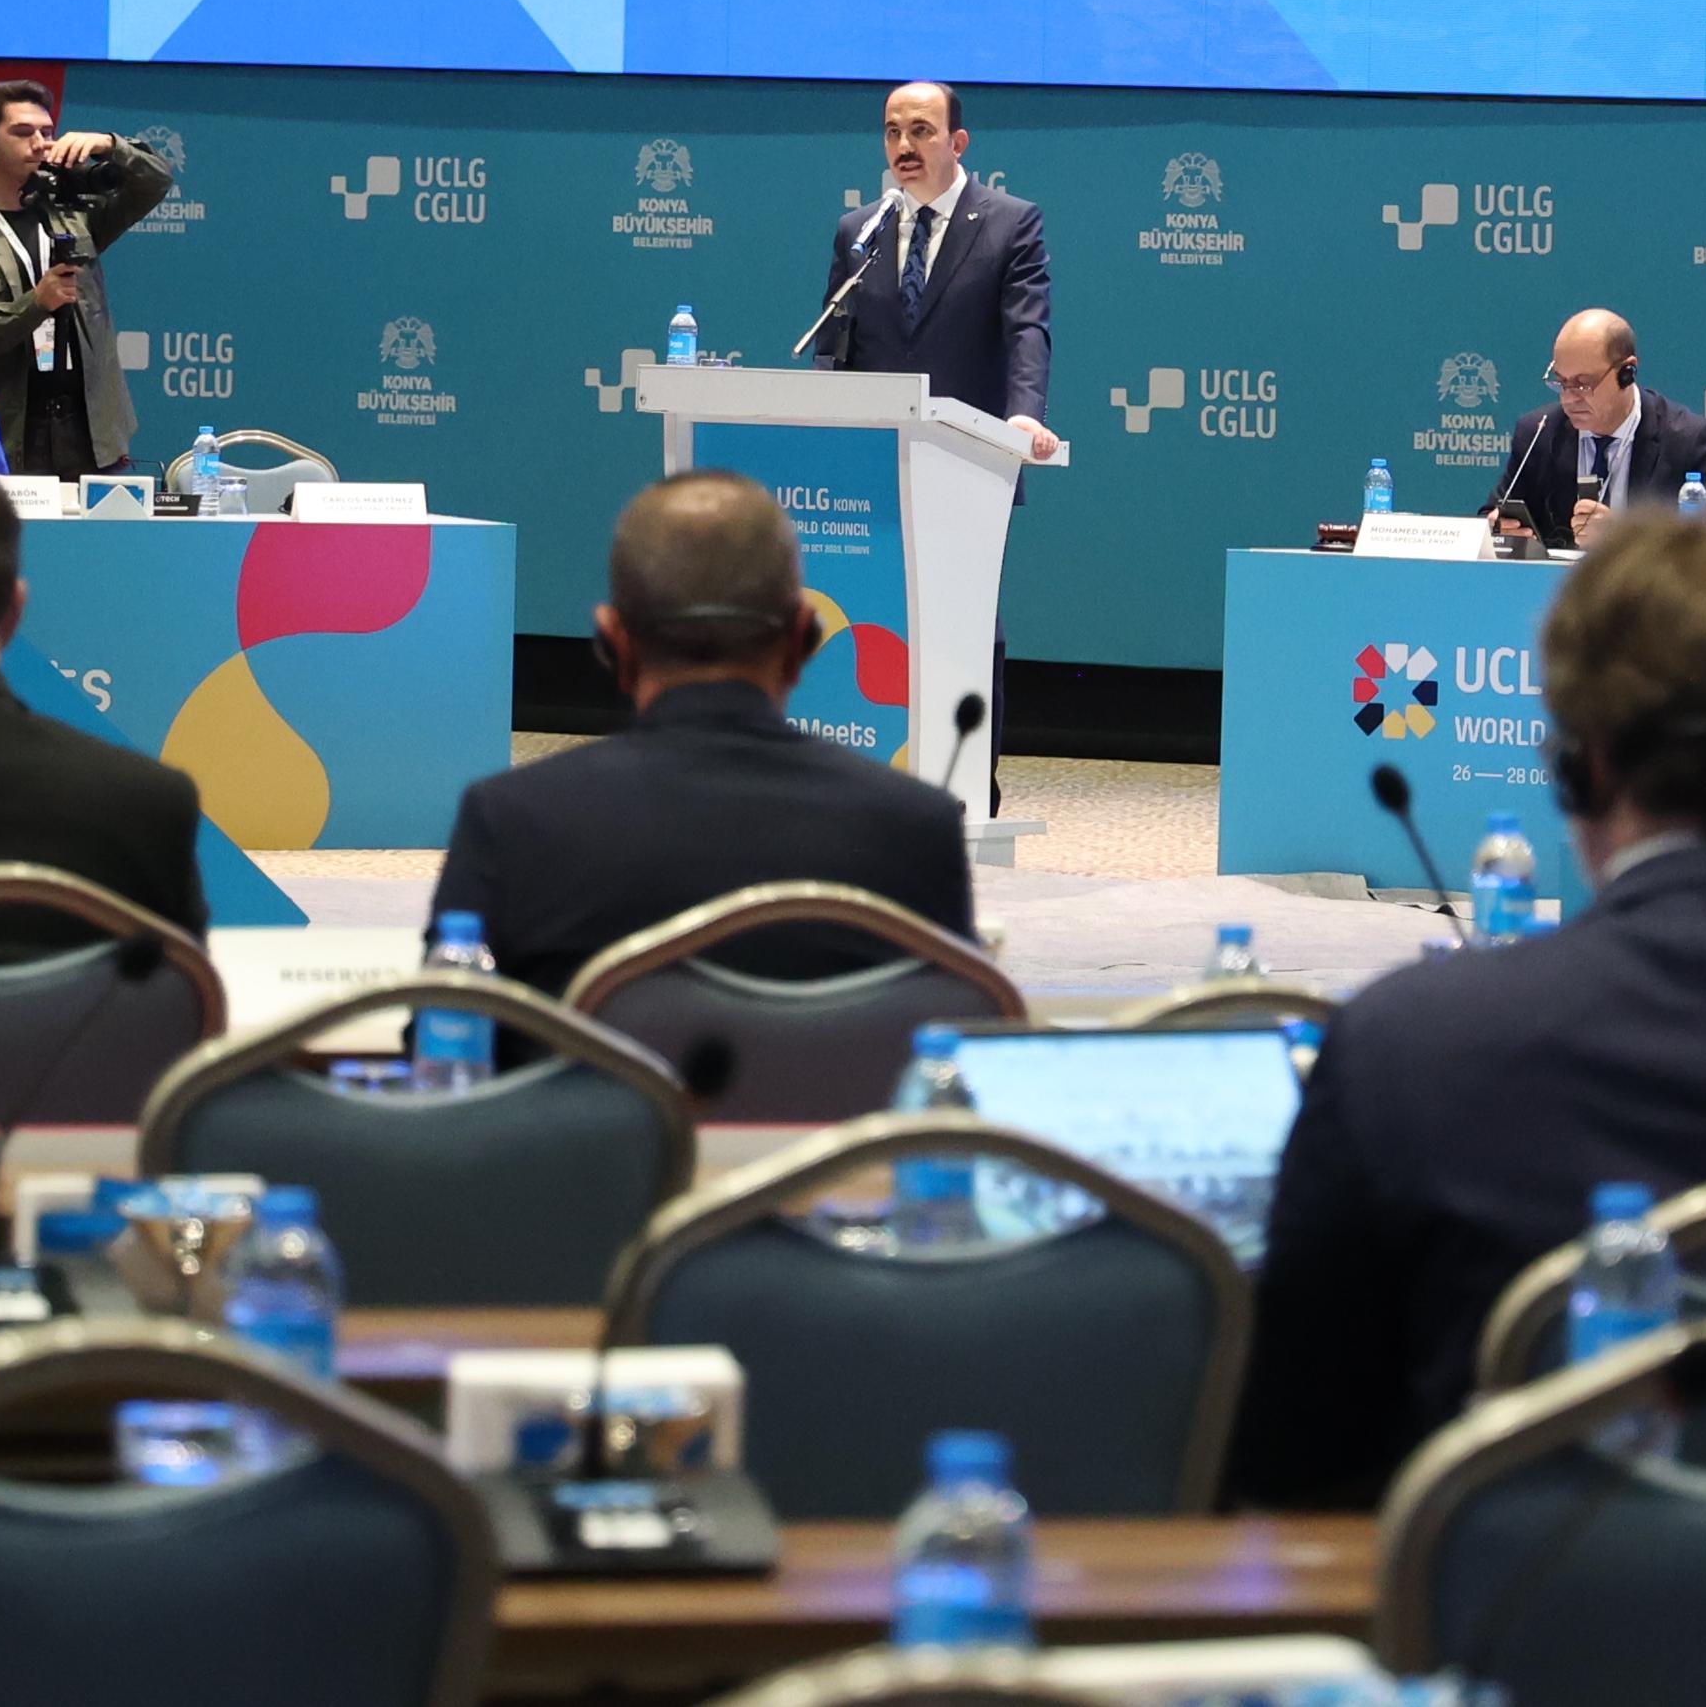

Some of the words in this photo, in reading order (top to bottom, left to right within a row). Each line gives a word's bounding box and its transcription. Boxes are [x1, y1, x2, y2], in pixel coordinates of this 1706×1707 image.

[415, 157, 485, 188] UCLG
[415, 192, 485, 223] CGLU
[639, 198, 688, 213] KONYA
[1475, 185, 1552, 217] UCLG
[1166, 214, 1218, 228] KONYA
[1475, 221, 1552, 254] CGLU
[164, 333, 233, 363] UCLG
[164, 367, 232, 398] CGLU
[383, 376, 431, 390] KONYA
[1201, 370, 1276, 402] UCLG
[1201, 405, 1276, 438] CGLU
[1440, 413, 1495, 431] KONYA
[776, 486, 830, 511] UCLG
[833, 498, 871, 513] KONYA
[822, 521, 870, 537] COUNCIL
[1454, 646, 1542, 695] UCL
[1454, 717, 1546, 746] WORLD
[1453, 765, 1471, 781] 26
[1507, 767, 1526, 784] 28
[1529, 768, 1549, 785] OC
